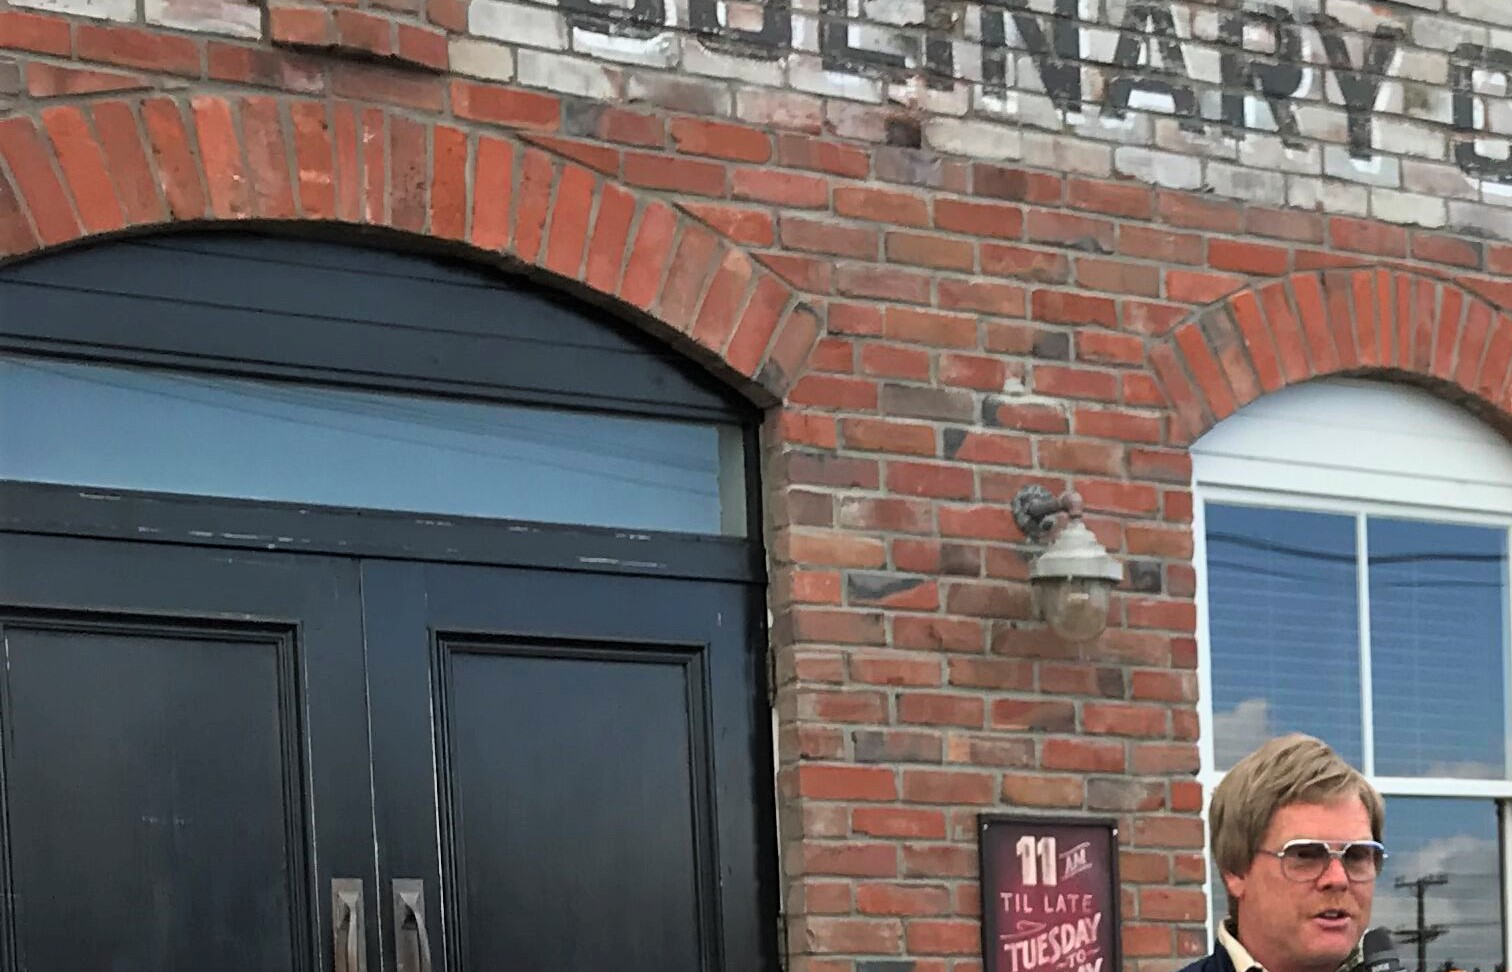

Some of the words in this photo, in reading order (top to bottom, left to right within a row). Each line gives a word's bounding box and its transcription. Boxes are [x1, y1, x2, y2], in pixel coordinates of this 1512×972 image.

[566, 0, 1403, 160] LINARY
[1015, 835, 1058, 886] 11
[1064, 849, 1088, 874] AM
[1000, 892, 1033, 914] TIL
[1044, 893, 1093, 915] LATE
[1003, 911, 1102, 972] TUESDAY
[1069, 951, 1087, 968] TO
